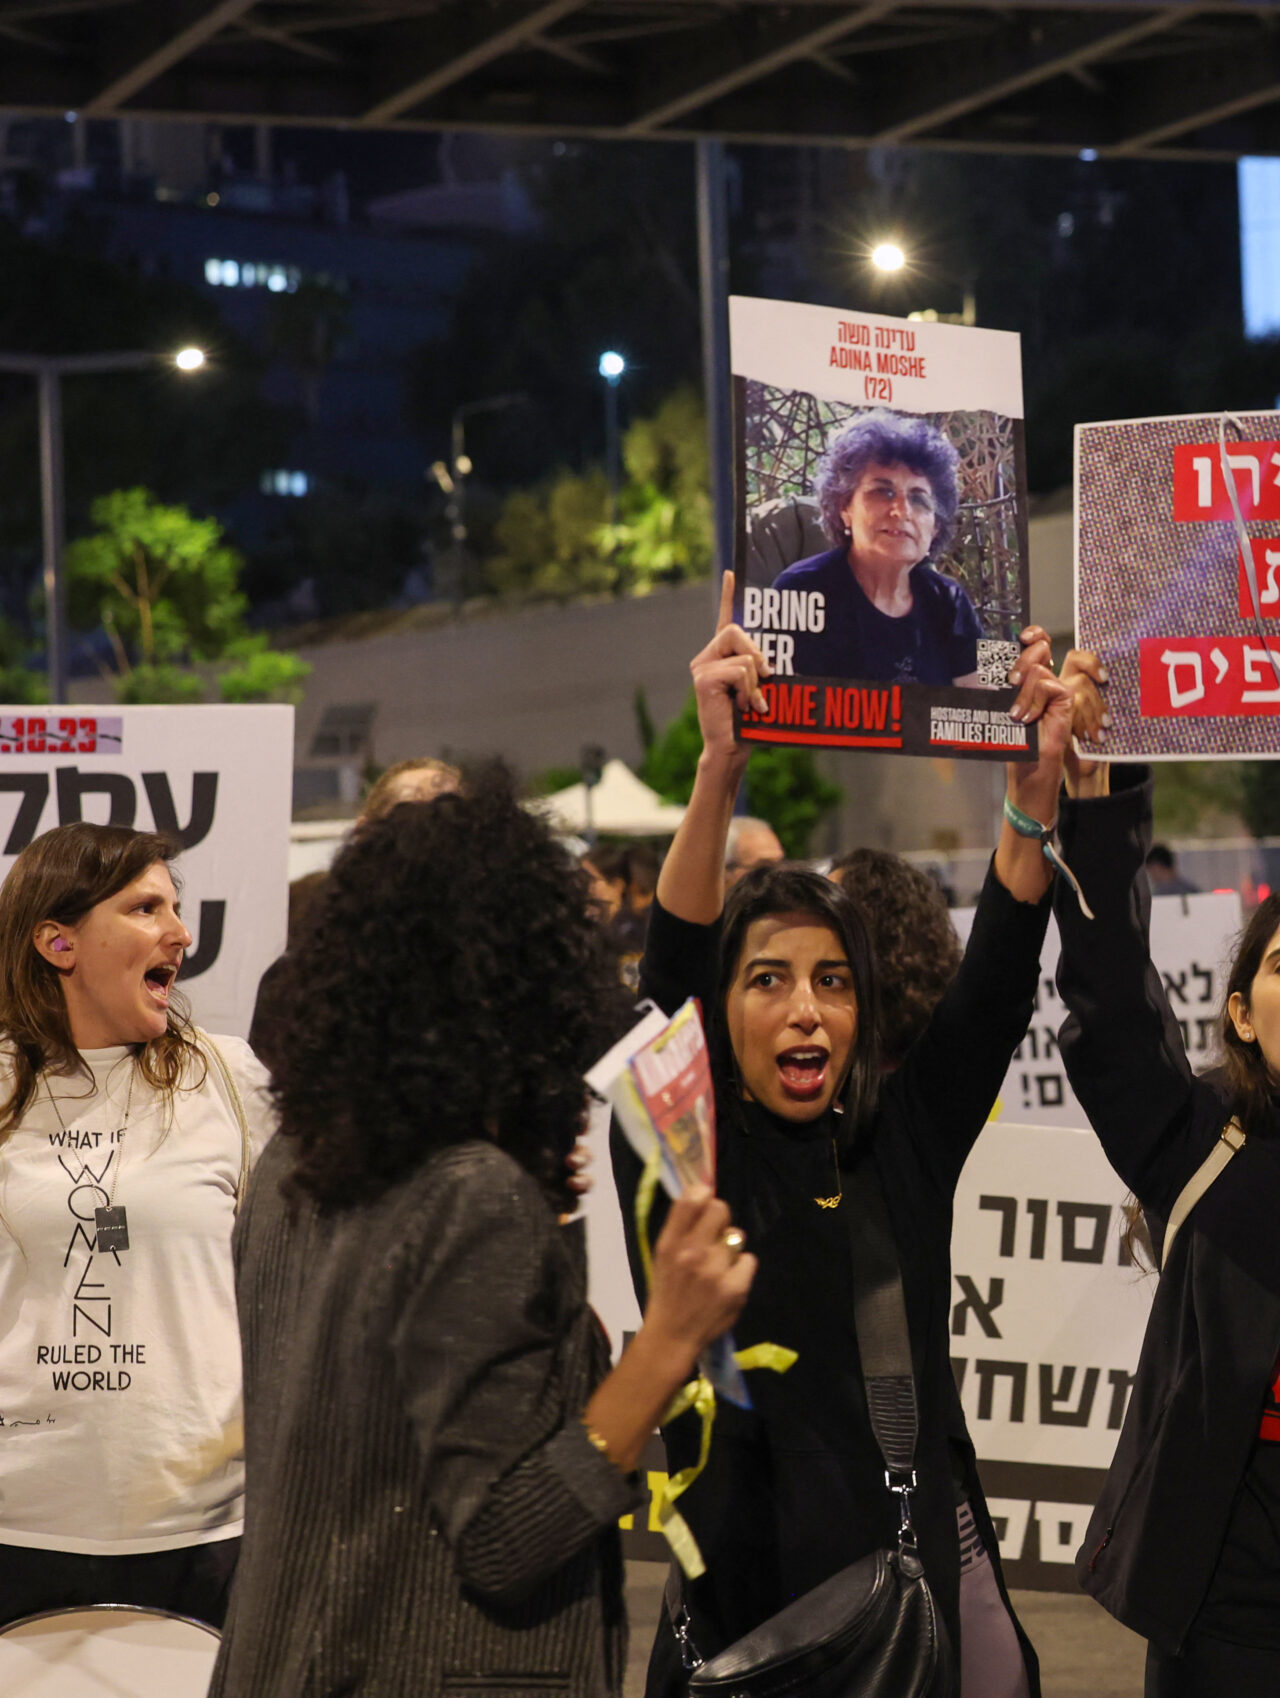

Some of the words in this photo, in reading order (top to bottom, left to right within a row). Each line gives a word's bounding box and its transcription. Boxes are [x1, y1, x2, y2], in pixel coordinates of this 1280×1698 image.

[838, 321, 871, 348] משה
[875, 327, 915, 351] עדינה
[829, 346, 872, 373] ADINA
[876, 353, 926, 379] MOSHE
[864, 374, 893, 403] (72)
[743, 587, 825, 633] BRING
[743, 683, 817, 727] OME
[825, 685, 902, 732] NOW!
[930, 706, 972, 723] HOSTAGES
[973, 709, 989, 724] AND
[0, 717, 97, 753] .10.23
[930, 720, 982, 743] FAMILIES
[985, 725, 1026, 746] FORUM
[49, 1130, 102, 1149] WHAT
[111, 1128, 127, 1144] IF
[37, 1345, 101, 1365] RULED
[110, 1345, 146, 1364] THE
[52, 1371, 131, 1391] WORLD
